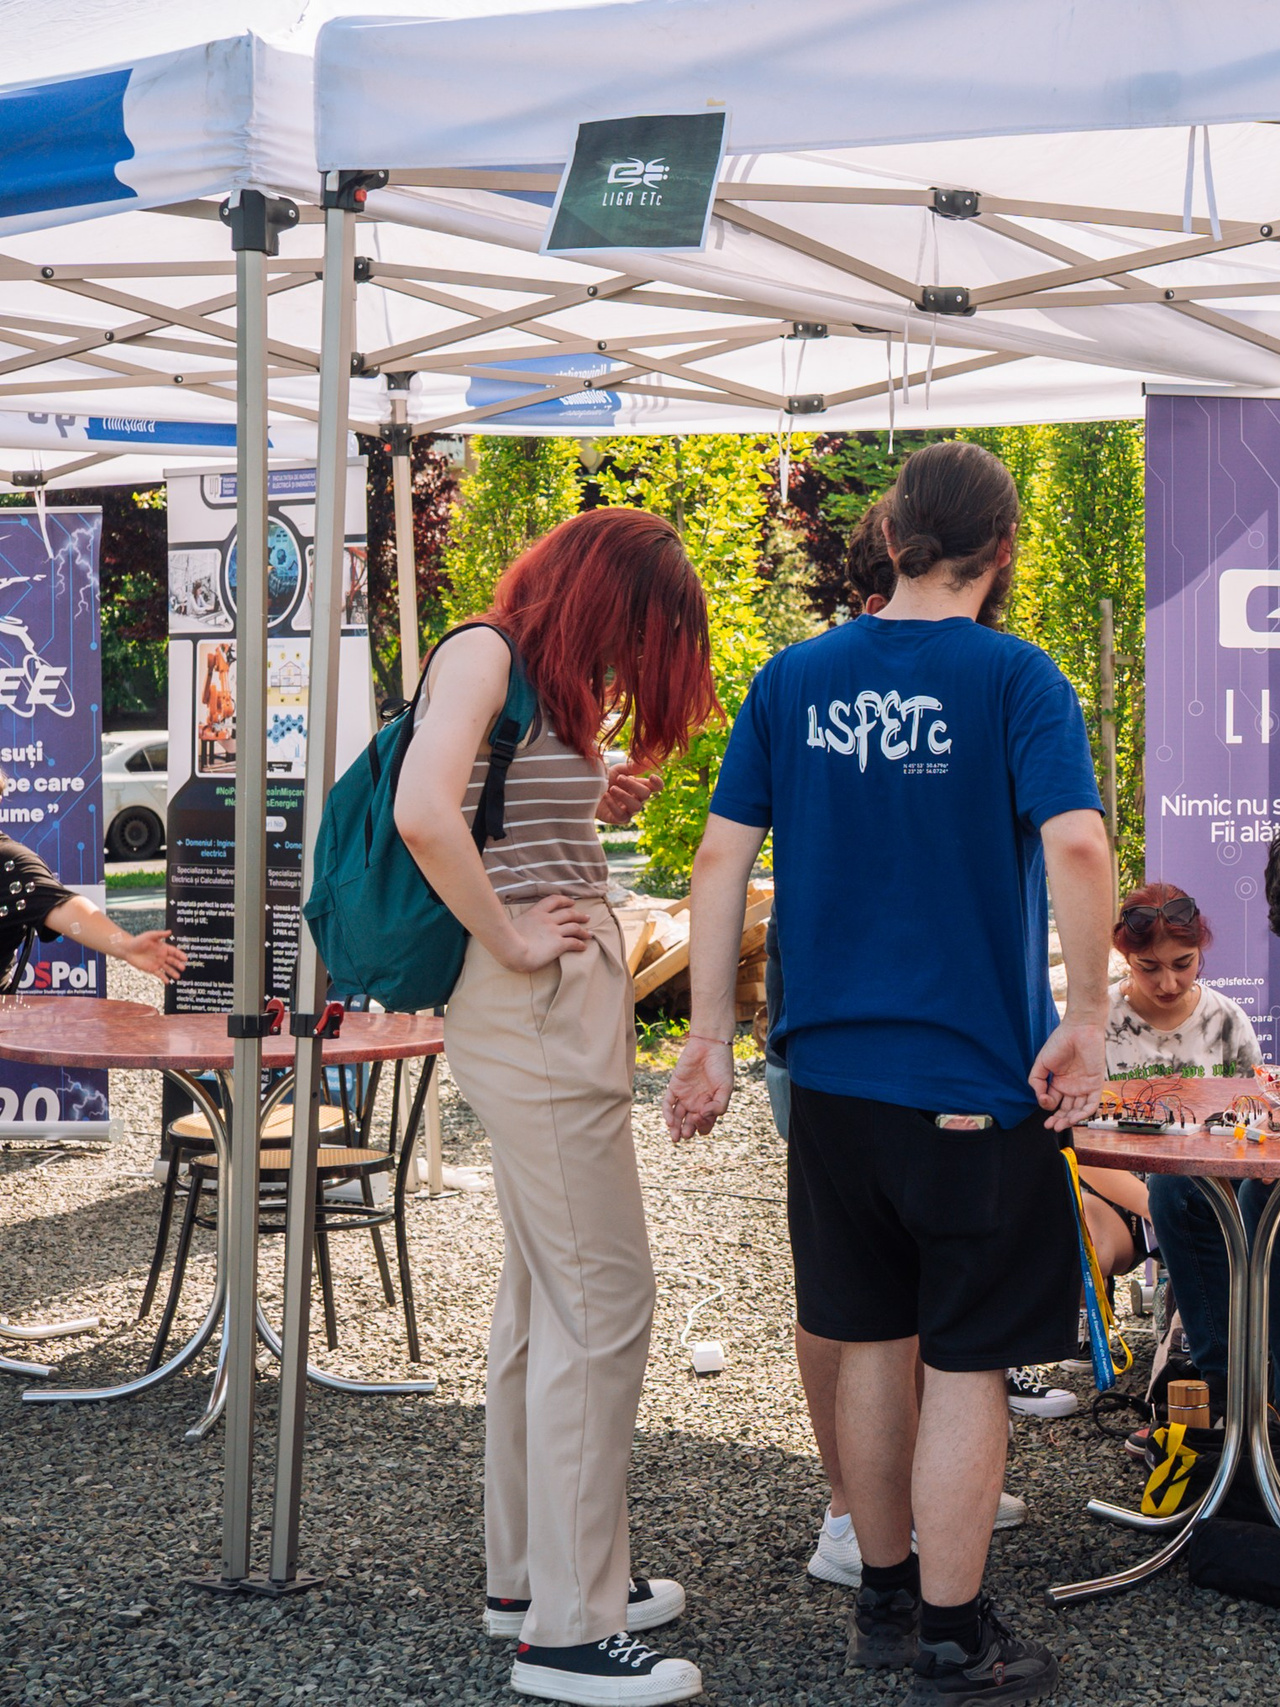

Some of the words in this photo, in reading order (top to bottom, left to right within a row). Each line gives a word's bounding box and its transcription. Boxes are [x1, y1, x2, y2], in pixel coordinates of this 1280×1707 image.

[602, 191, 633, 206] LIGA
[3, 777, 31, 796] pe
[34, 777, 84, 792] care
[1162, 794, 1232, 816] Nimic
[1237, 798, 1267, 815] nu
[1211, 820, 1235, 842] Fii
